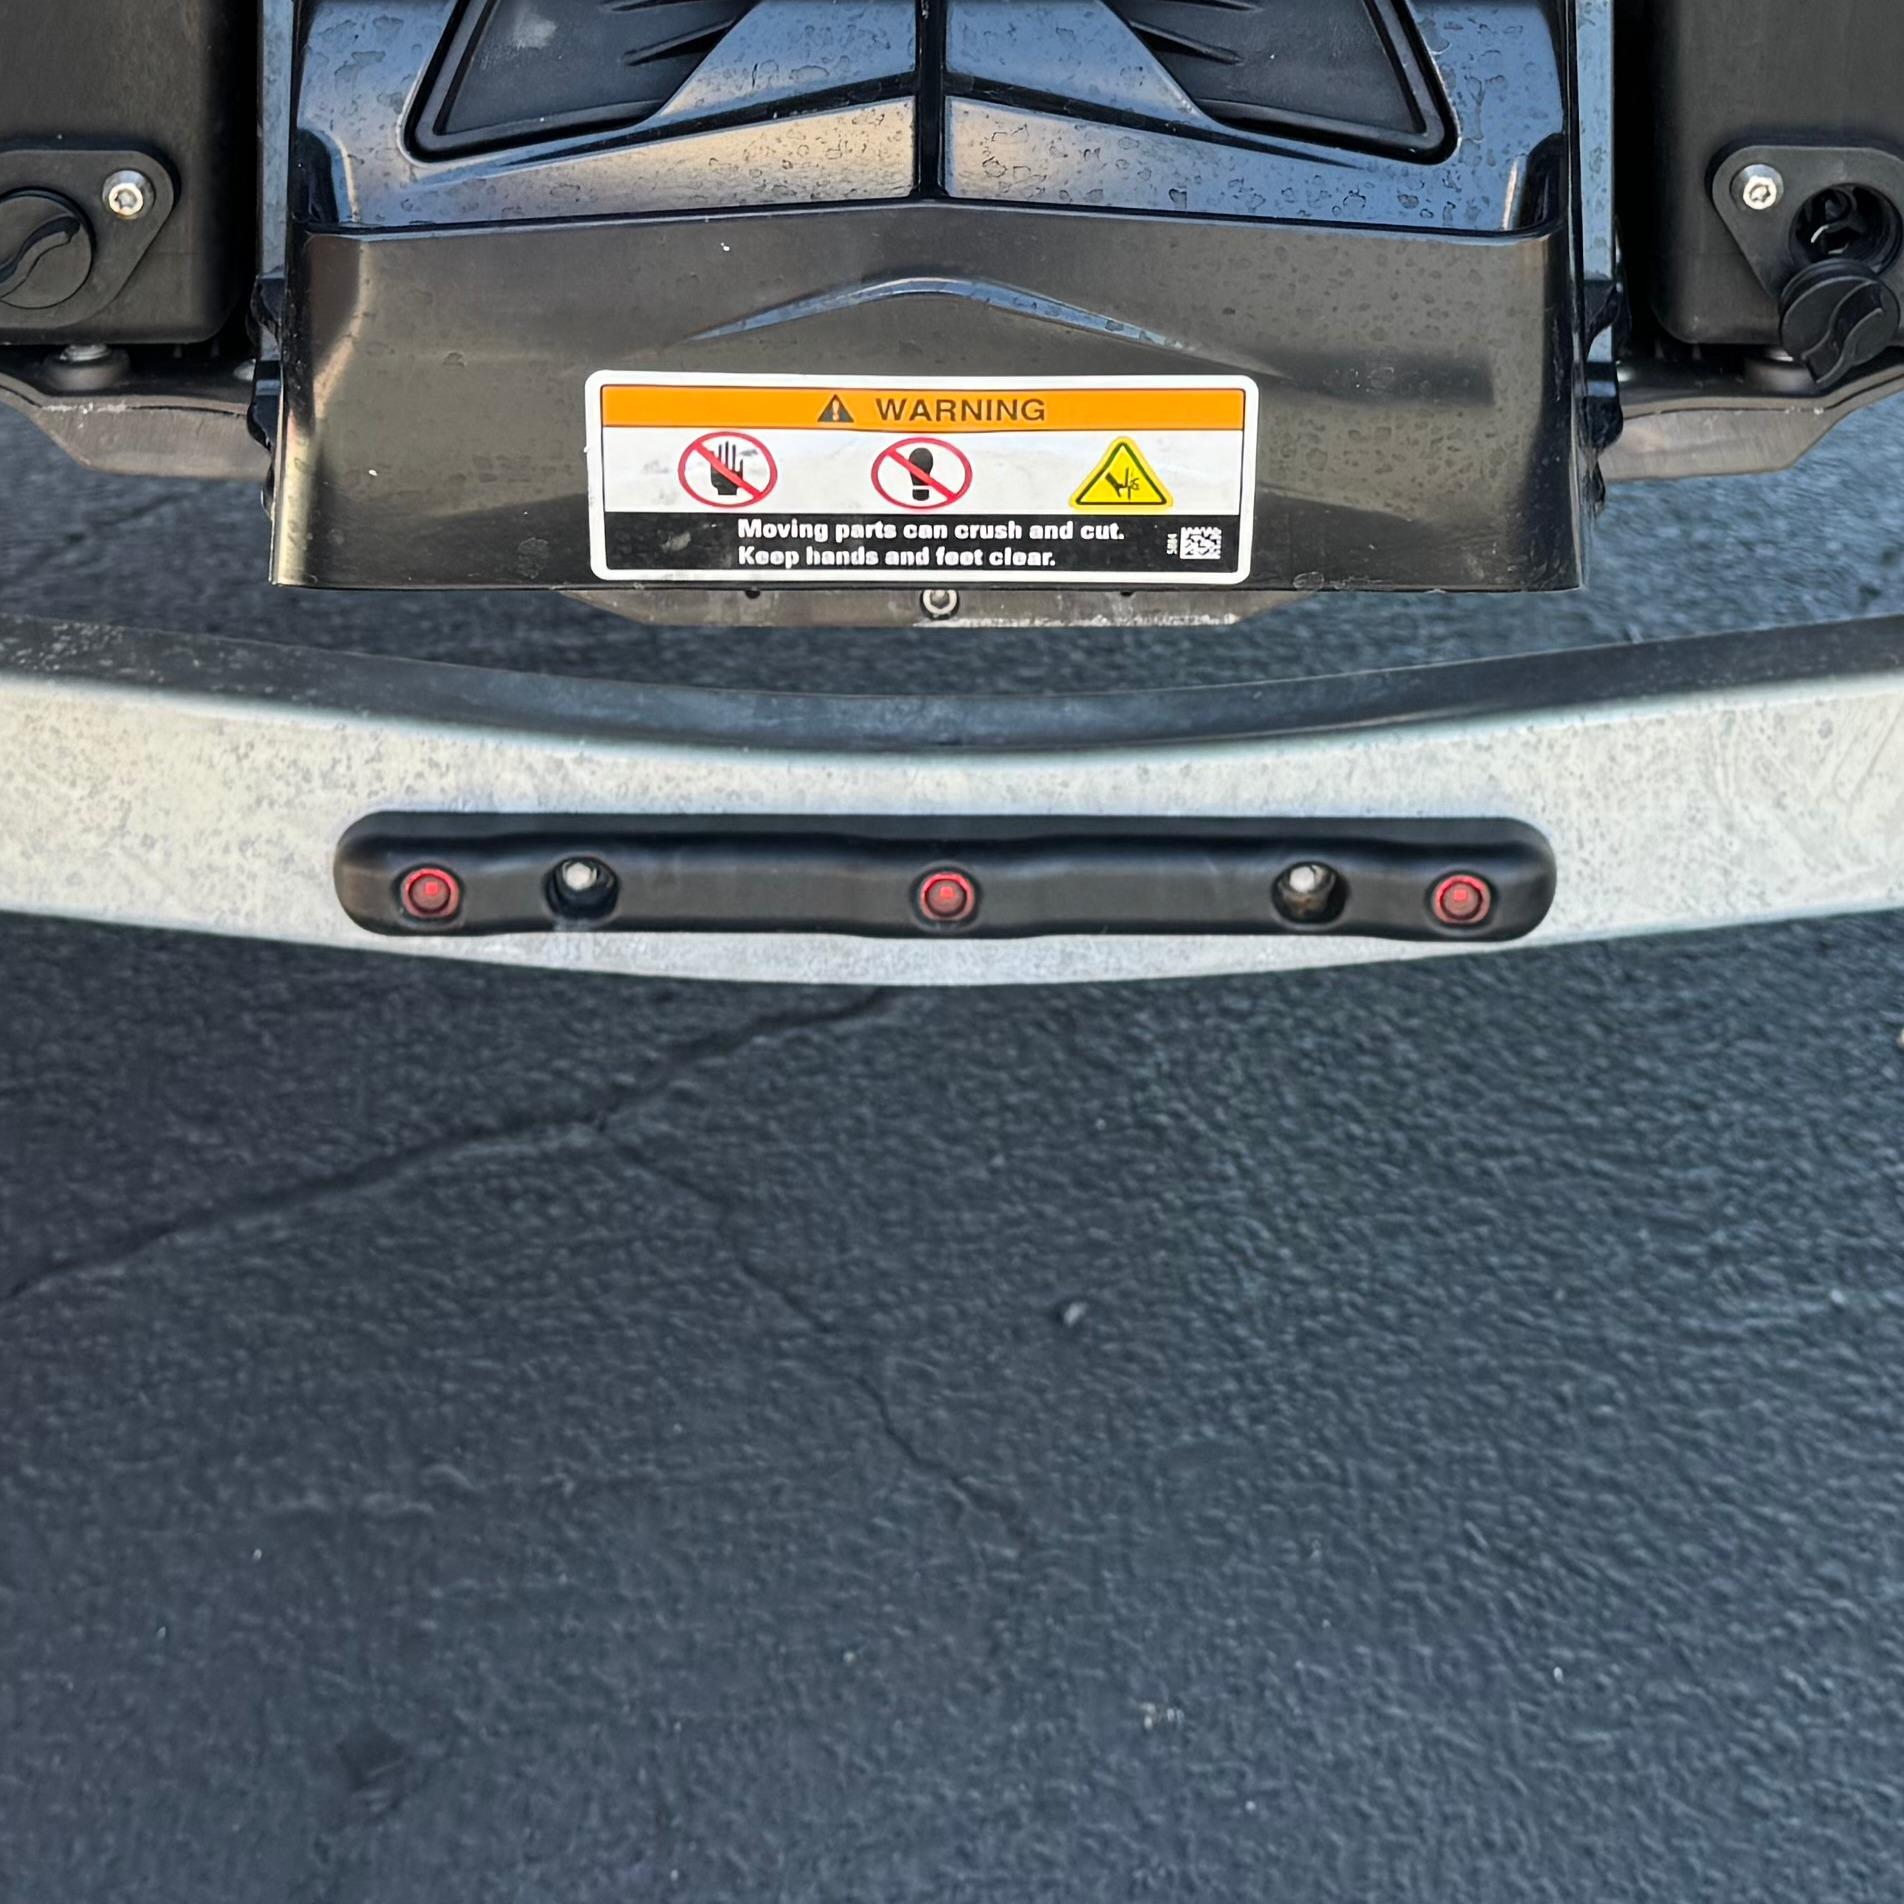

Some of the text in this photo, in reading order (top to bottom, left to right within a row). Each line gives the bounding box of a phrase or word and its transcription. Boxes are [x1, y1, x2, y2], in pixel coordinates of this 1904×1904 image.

[875, 398, 1046, 422] WARNING
[737, 518, 1125, 543] Moving parts can crush and cut.
[738, 545, 800, 569] Keep
[806, 545, 879, 565] hands
[884, 546, 930, 566] and
[988, 547, 1056, 566] clear.
